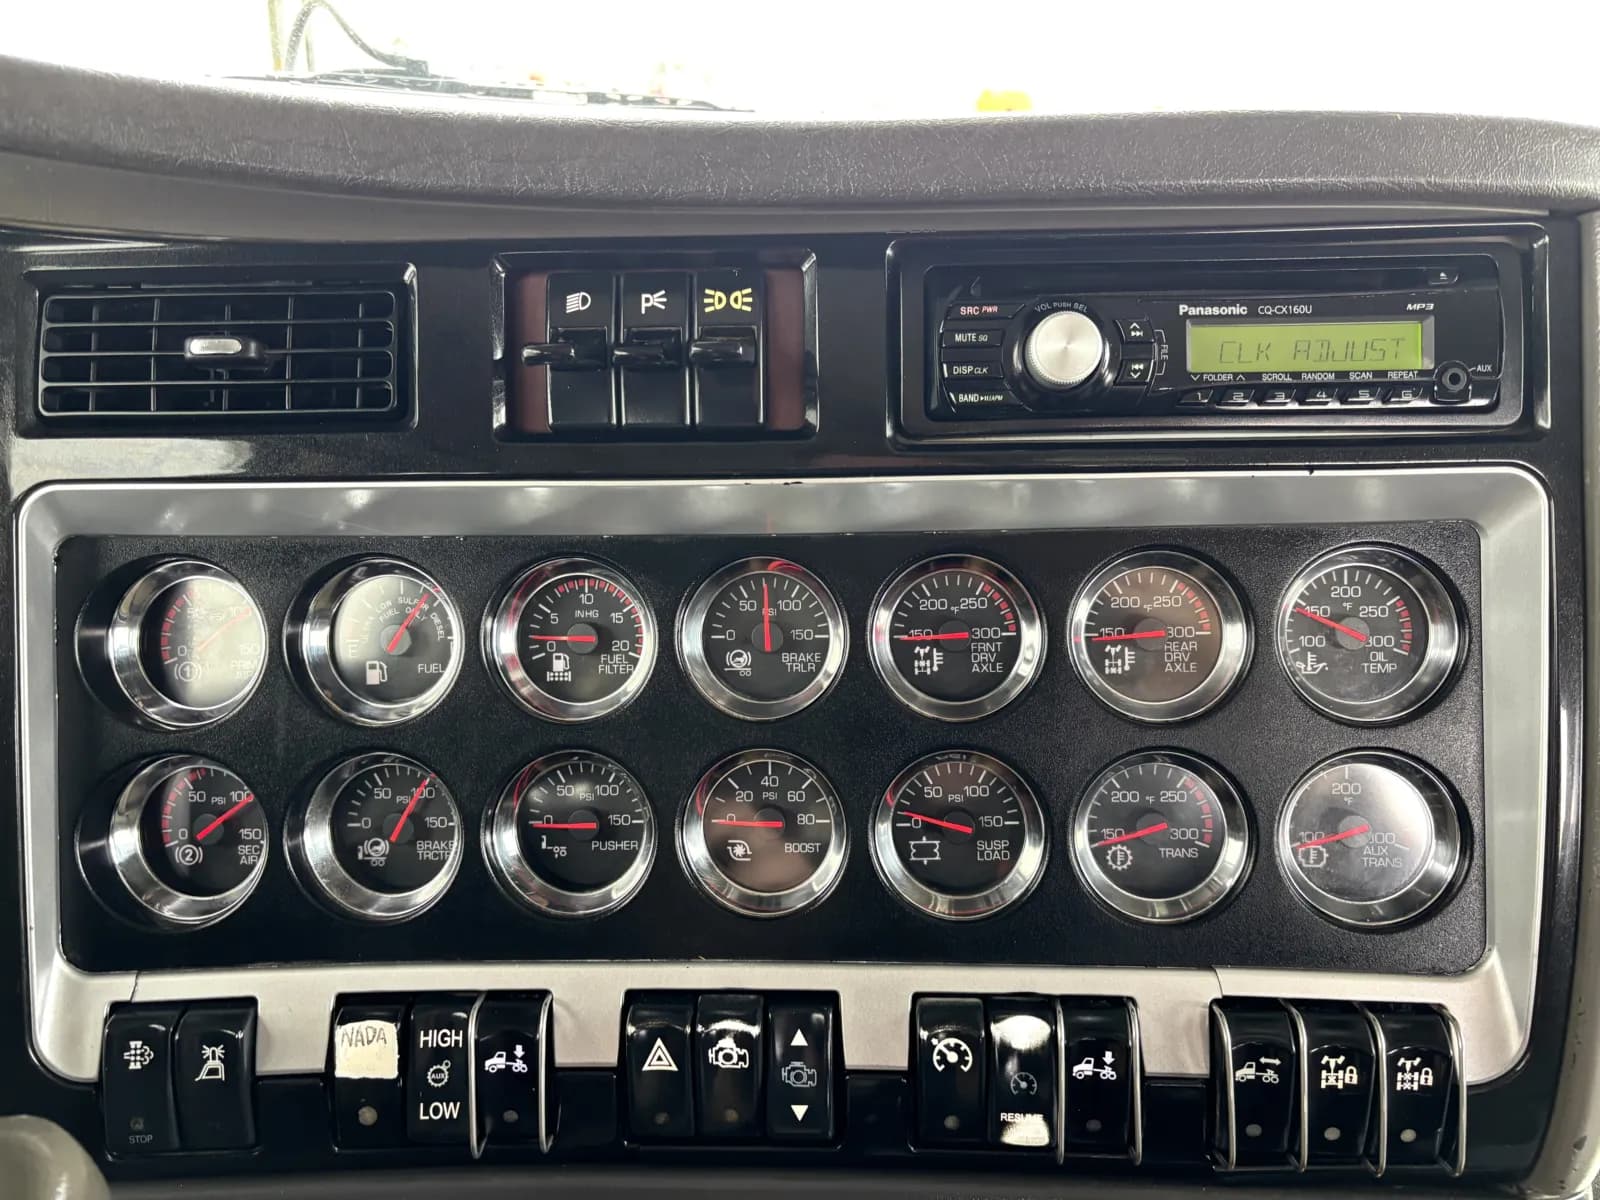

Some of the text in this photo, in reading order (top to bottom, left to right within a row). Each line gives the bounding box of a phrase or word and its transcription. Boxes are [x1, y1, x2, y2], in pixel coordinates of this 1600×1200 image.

[960, 305, 998, 315] SRC PWR
[1034, 302, 1052, 312] VOL
[1073, 302, 1088, 313] SEL
[1179, 304, 1313, 316] Panasonic CQ-CX160U
[1406, 303, 1435, 311] MP3
[955, 333, 977, 342] MUTE
[1160, 344, 1169, 360] FILE
[1219, 338, 1405, 364] CLK ADJUST
[953, 366, 989, 375] DISP CLK
[1477, 364, 1492, 372] AUX
[1203, 373, 1234, 381] FOLDER
[1262, 372, 1293, 381] SCROLL
[1301, 372, 1335, 380] RANDOM
[1349, 371, 1373, 379] SCAN
[1387, 370, 1418, 379] REPEAT
[959, 394, 979, 402] BAND
[1197, 392, 1202, 401] 1
[1233, 392, 1244, 400] 2
[1274, 392, 1285, 401] 3
[1316, 390, 1328, 398] 4
[1330, 586, 1361, 598] 200
[398, 596, 430, 612] SULFR
[579, 593, 594, 605] 10
[919, 599, 948, 610] 200
[960, 598, 988, 609] 250
[1110, 597, 1140, 608] 200
[1153, 596, 1182, 607] 250
[739, 600, 757, 612] 50
[777, 600, 802, 611] 100
[405, 606, 428, 621] OLY
[1359, 606, 1389, 618] 250
[550, 613, 559, 624] 5
[610, 612, 624, 624] 15
[726, 629, 736, 641] 0
[790, 629, 814, 640] 150
[971, 628, 1000, 639] 300
[1100, 627, 1125, 639] 150
[1167, 626, 1195, 638] 300
[547, 641, 556, 652] 0
[611, 640, 630, 652] 20
[971, 642, 1002, 652] FRNT
[1164, 641, 1198, 652] REAR
[1299, 635, 1326, 648] 100
[600, 654, 628, 664] FUEL
[781, 653, 822, 662] BRAKE
[971, 653, 997, 663] DRV
[1164, 653, 1190, 662] DRV
[1369, 651, 1388, 662] OIL
[418, 663, 445, 674] FUEL
[598, 664, 634, 675] FILTER
[786, 663, 816, 673] TRLR
[971, 663, 1003, 673] AXLE
[1164, 662, 1198, 673] AXLE
[1361, 663, 1397, 674] TEMP
[760, 776, 779, 787] 40
[374, 788, 392, 799] 50
[556, 785, 574, 796] 50
[594, 785, 619, 796] 100
[924, 786, 943, 798] 50
[963, 785, 990, 797] 100
[1331, 783, 1362, 795] 200
[188, 791, 206, 802] 50
[211, 797, 226, 805] PSI
[229, 791, 254, 802] 100
[396, 796, 411, 804] PSI
[579, 793, 595, 801] PSI
[735, 790, 754, 802] 20
[762, 792, 778, 800] PSI
[787, 790, 806, 802] 60
[948, 794, 964, 803] PSI
[1111, 791, 1140, 803] 200
[1160, 791, 1187, 802] 250
[361, 817, 372, 829] 0
[424, 817, 448, 828] 150
[608, 814, 631, 826] 150
[797, 814, 815, 825] 80
[911, 818, 922, 829] 0
[978, 816, 1003, 827] 150
[178, 828, 188, 840] 0
[238, 828, 262, 840] 150
[1101, 828, 1125, 840] 150
[1170, 828, 1199, 840] 300
[1299, 831, 1325, 843] 100
[237, 845, 260, 855] SEC
[416, 840, 456, 850] BRAKE
[591, 841, 639, 851] PUSHER
[784, 843, 821, 853] BOOST
[976, 840, 1009, 850] SUSP
[1363, 846, 1389, 855] AUX
[977, 851, 1010, 861] LOAD
[1159, 848, 1199, 858] TRANS
[240, 856, 258, 865] AIR
[1361, 857, 1402, 867] TRANS
[340, 1025, 388, 1048] NADA
[419, 1028, 464, 1048] HIGH
[431, 1072, 446, 1080] AUX
[419, 1101, 461, 1120] LOW
[129, 1135, 153, 1144] STOP
